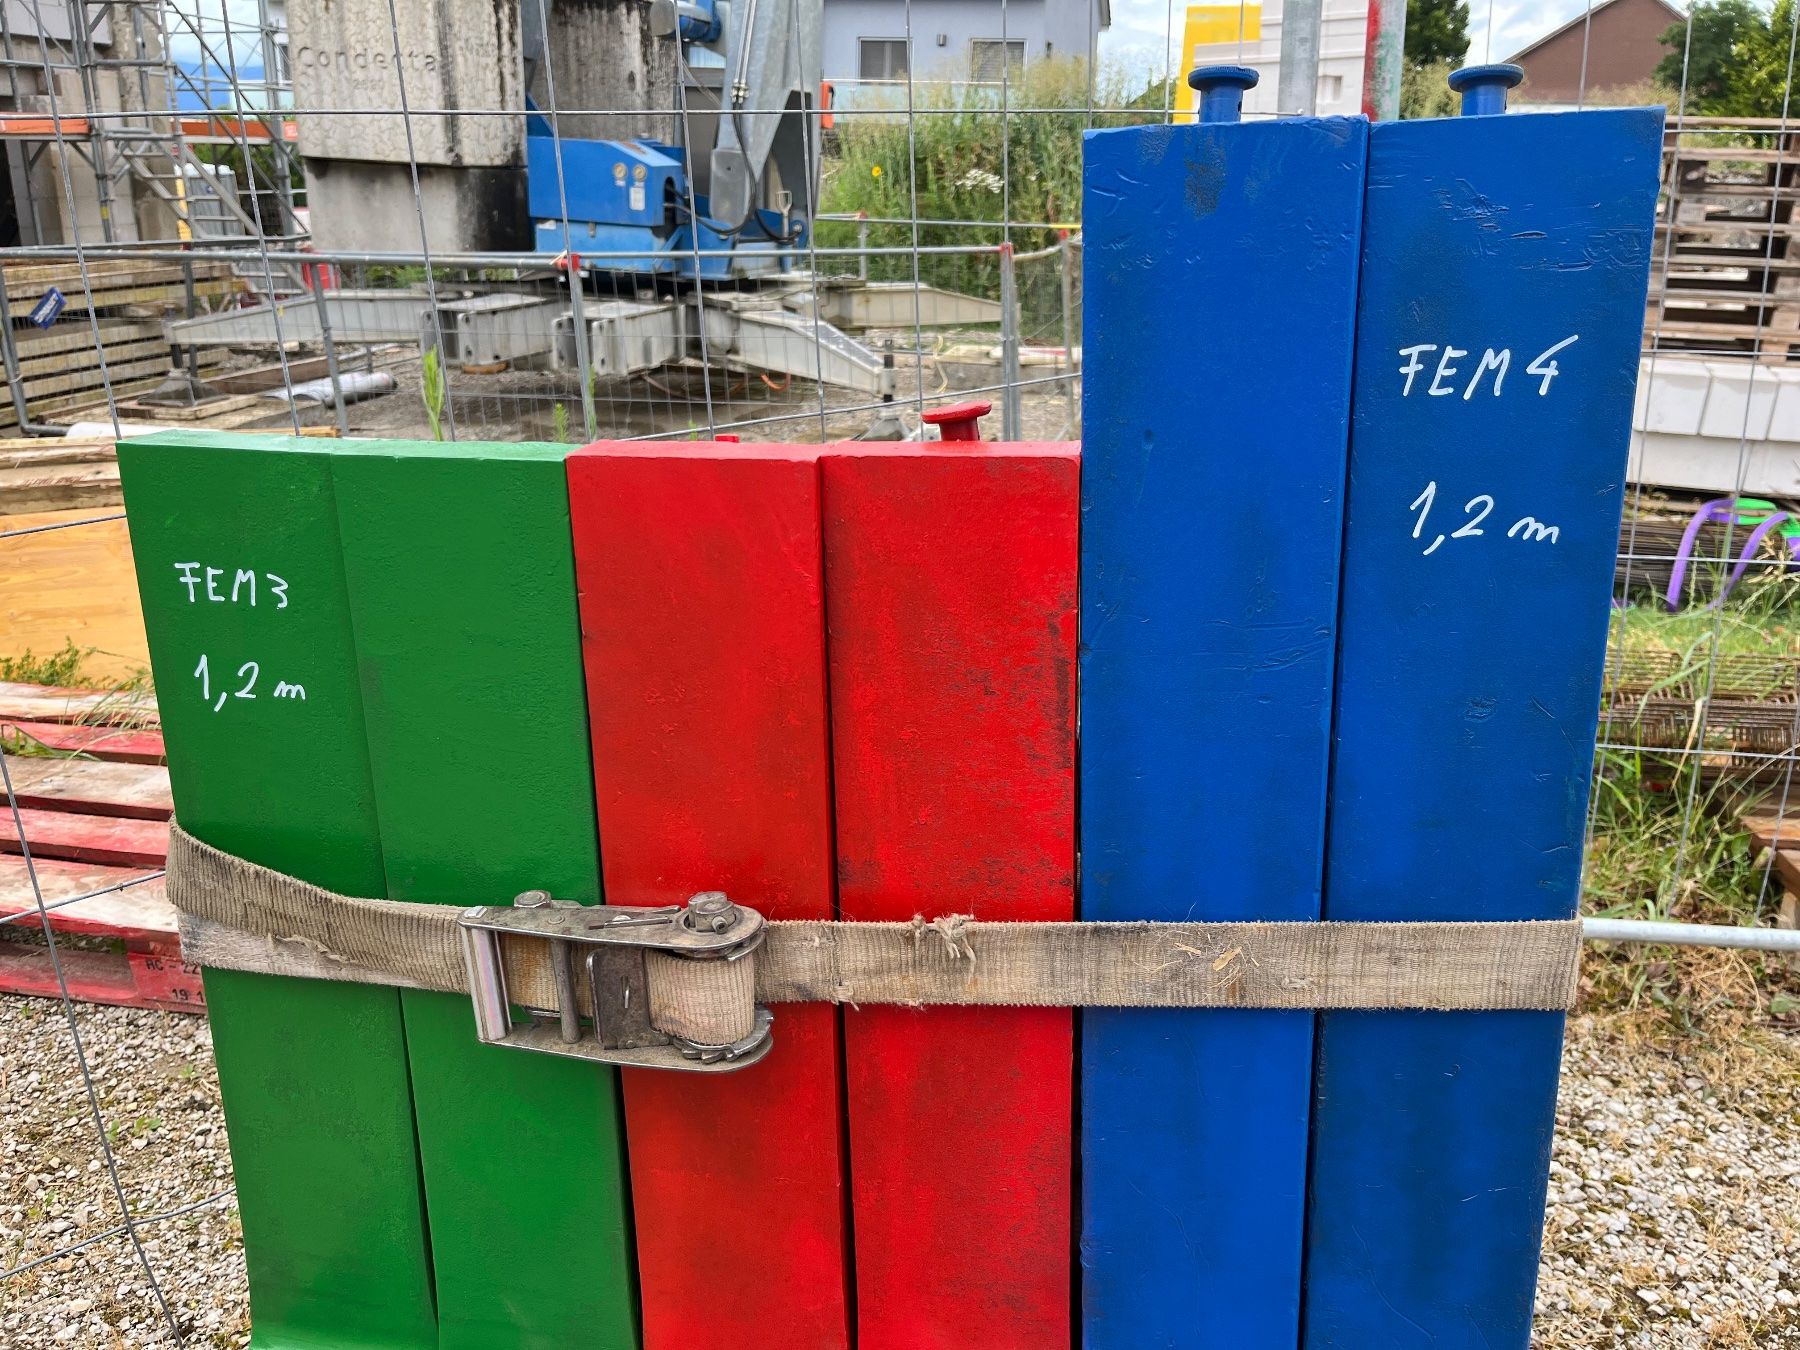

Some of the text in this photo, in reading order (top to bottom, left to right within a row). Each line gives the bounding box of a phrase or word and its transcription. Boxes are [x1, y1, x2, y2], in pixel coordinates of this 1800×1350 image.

[1398, 334, 1579, 401] FEM 4
[1409, 480, 1560, 556] 1,2 m
[194, 654, 306, 713] 1,2 m
